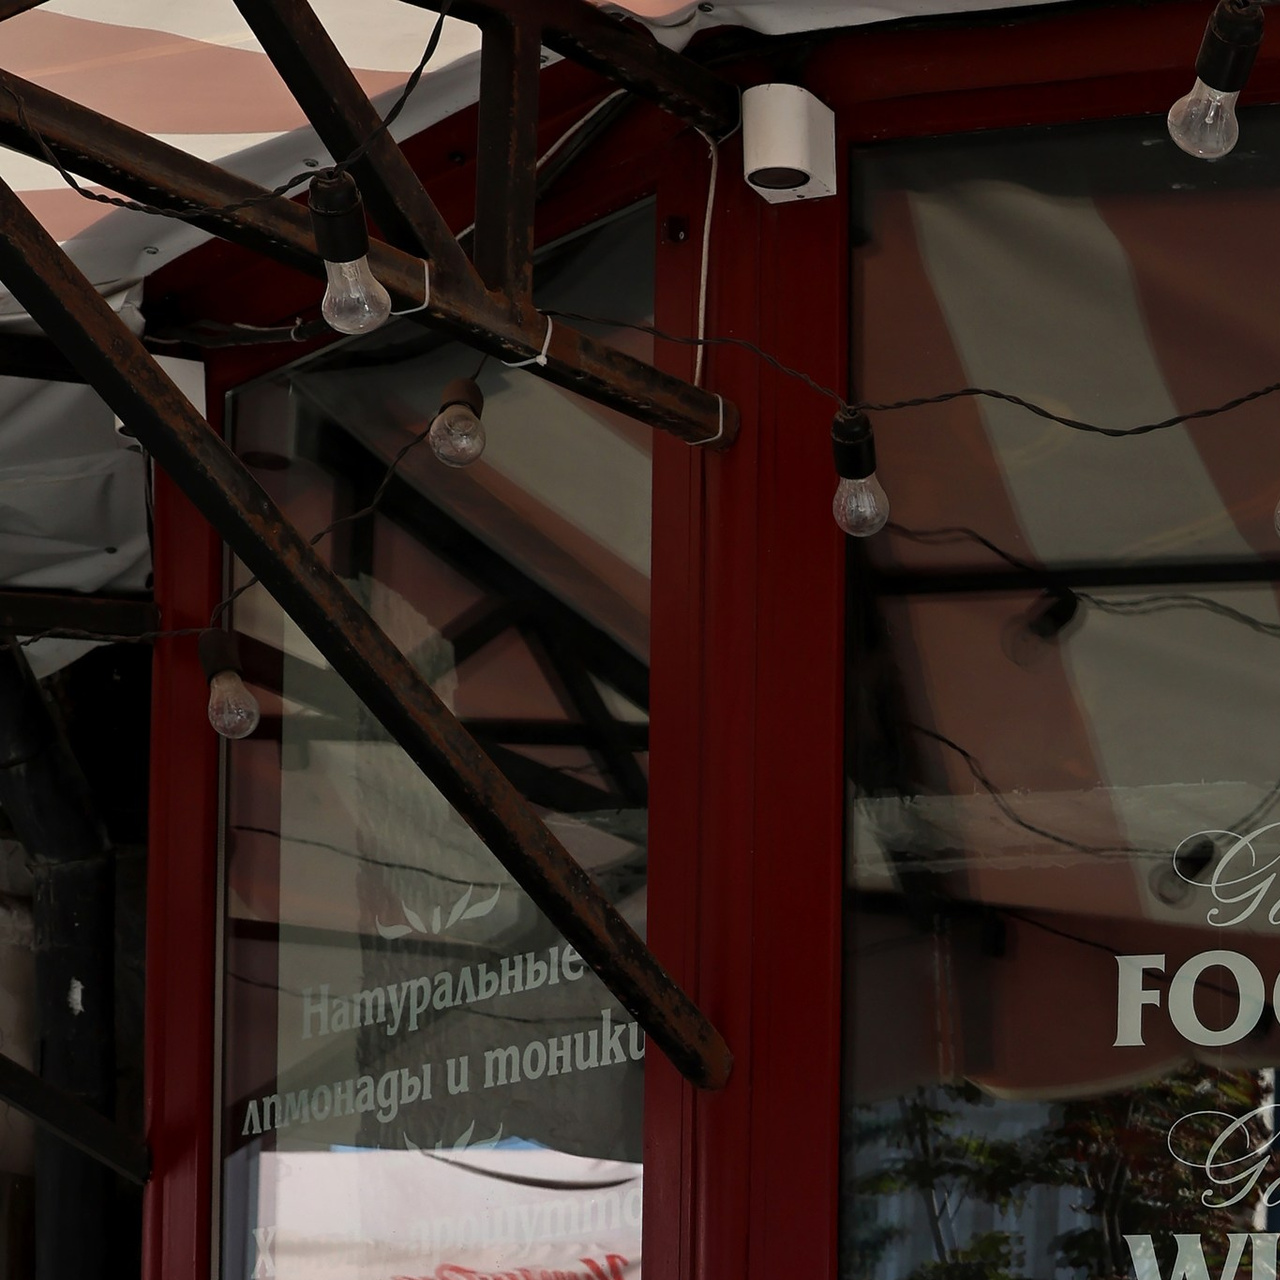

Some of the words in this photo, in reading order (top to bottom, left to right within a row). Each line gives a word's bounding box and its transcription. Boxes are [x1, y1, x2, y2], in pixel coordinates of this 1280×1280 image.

[301, 942, 586, 1041] Натуральные
[446, 1055, 471, 1095] и
[483, 1008, 646, 1089] тоники
